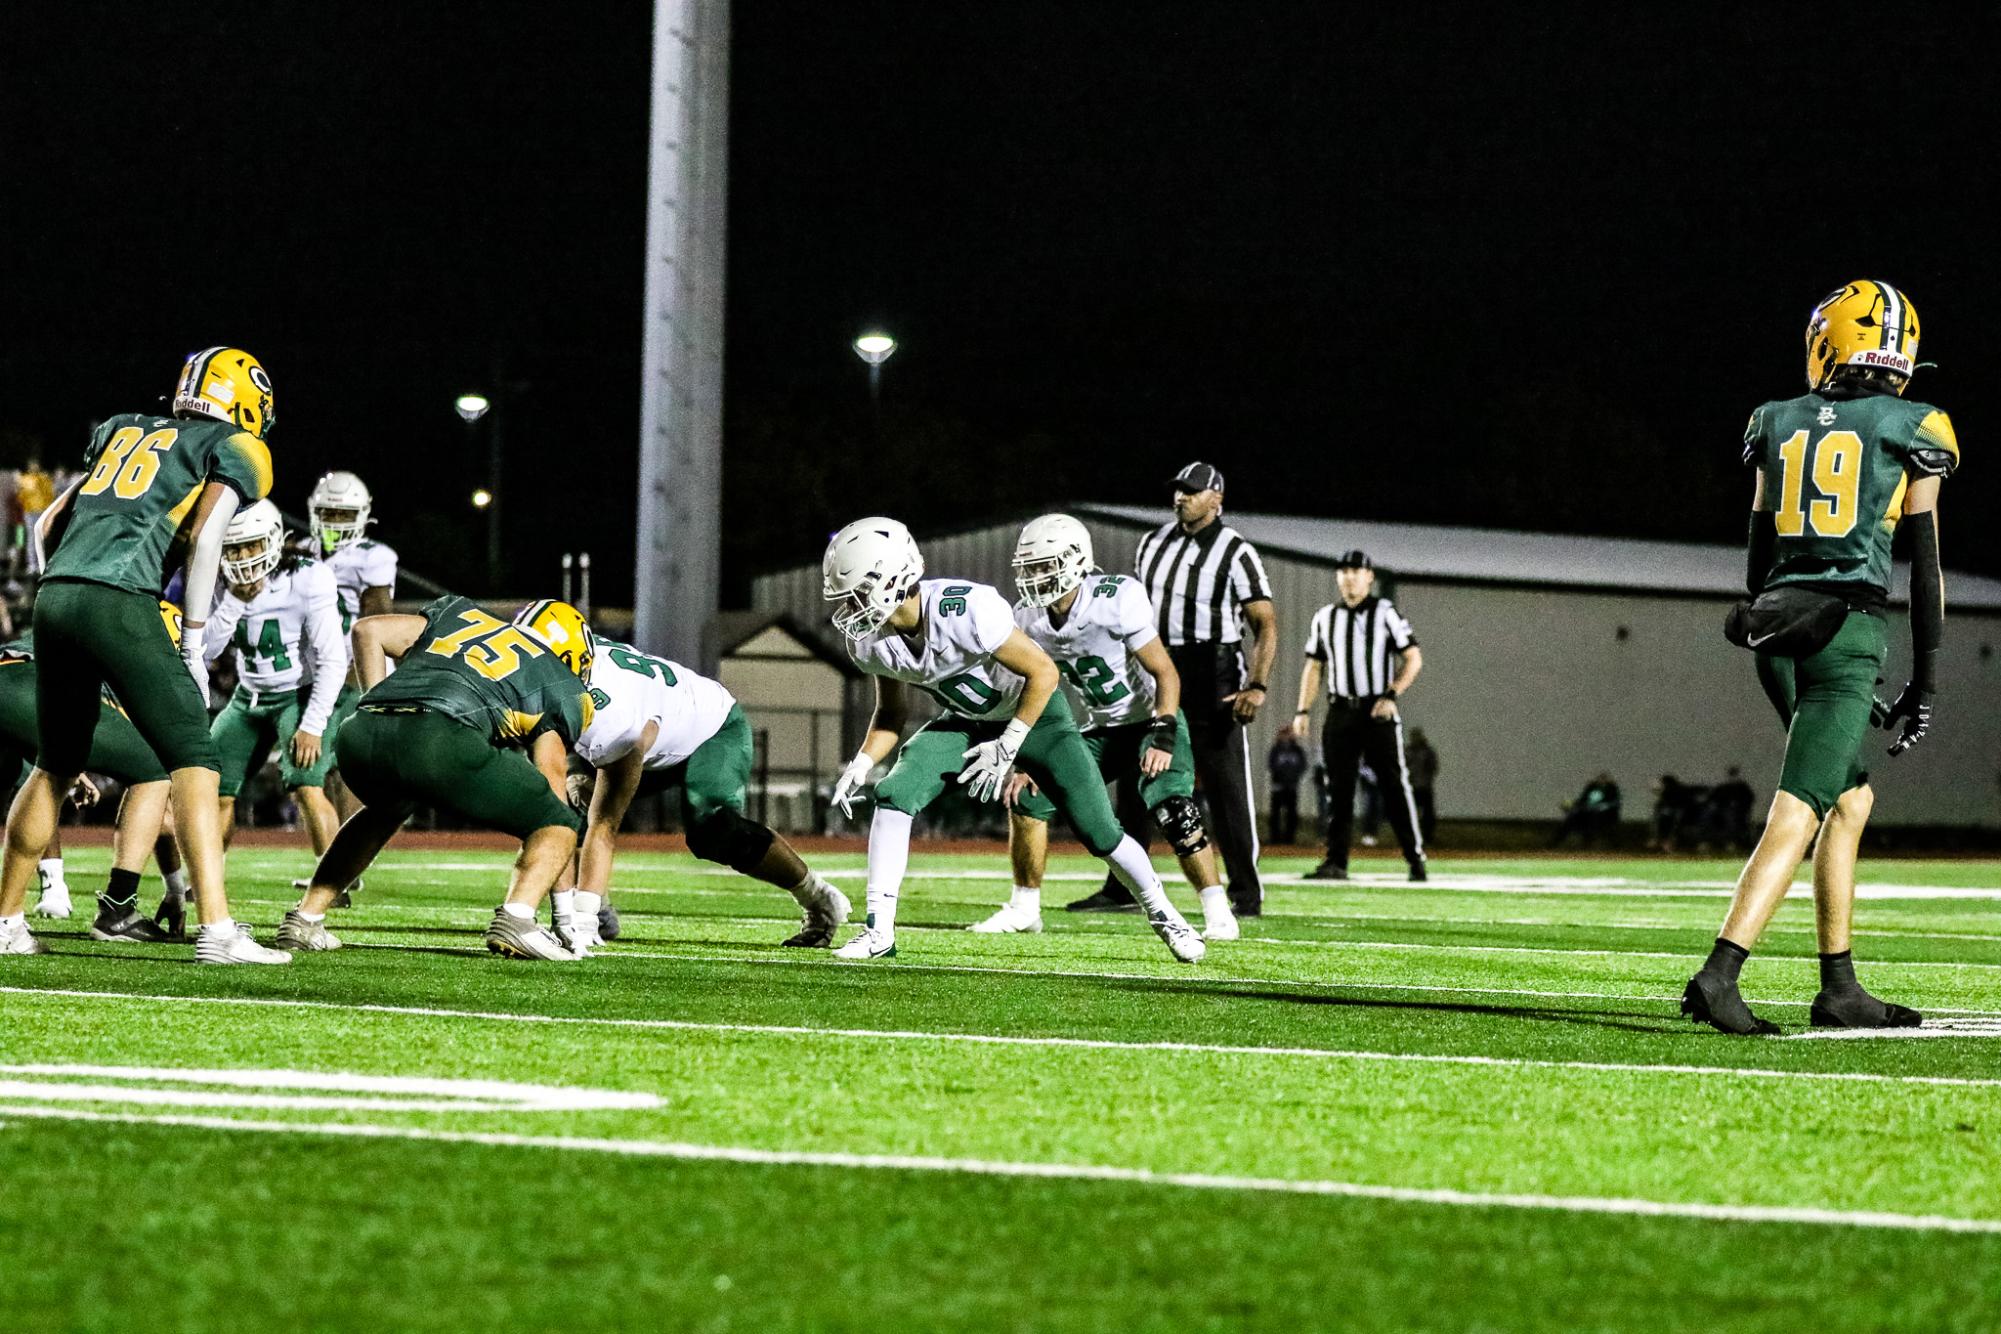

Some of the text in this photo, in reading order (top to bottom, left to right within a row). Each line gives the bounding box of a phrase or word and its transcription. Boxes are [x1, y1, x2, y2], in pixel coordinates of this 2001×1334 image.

[1864, 352, 1909, 371] Riddell
[79, 426, 179, 500] 86
[1775, 429, 1864, 538] 19
[939, 585, 973, 618] 30
[425, 608, 546, 682] 75
